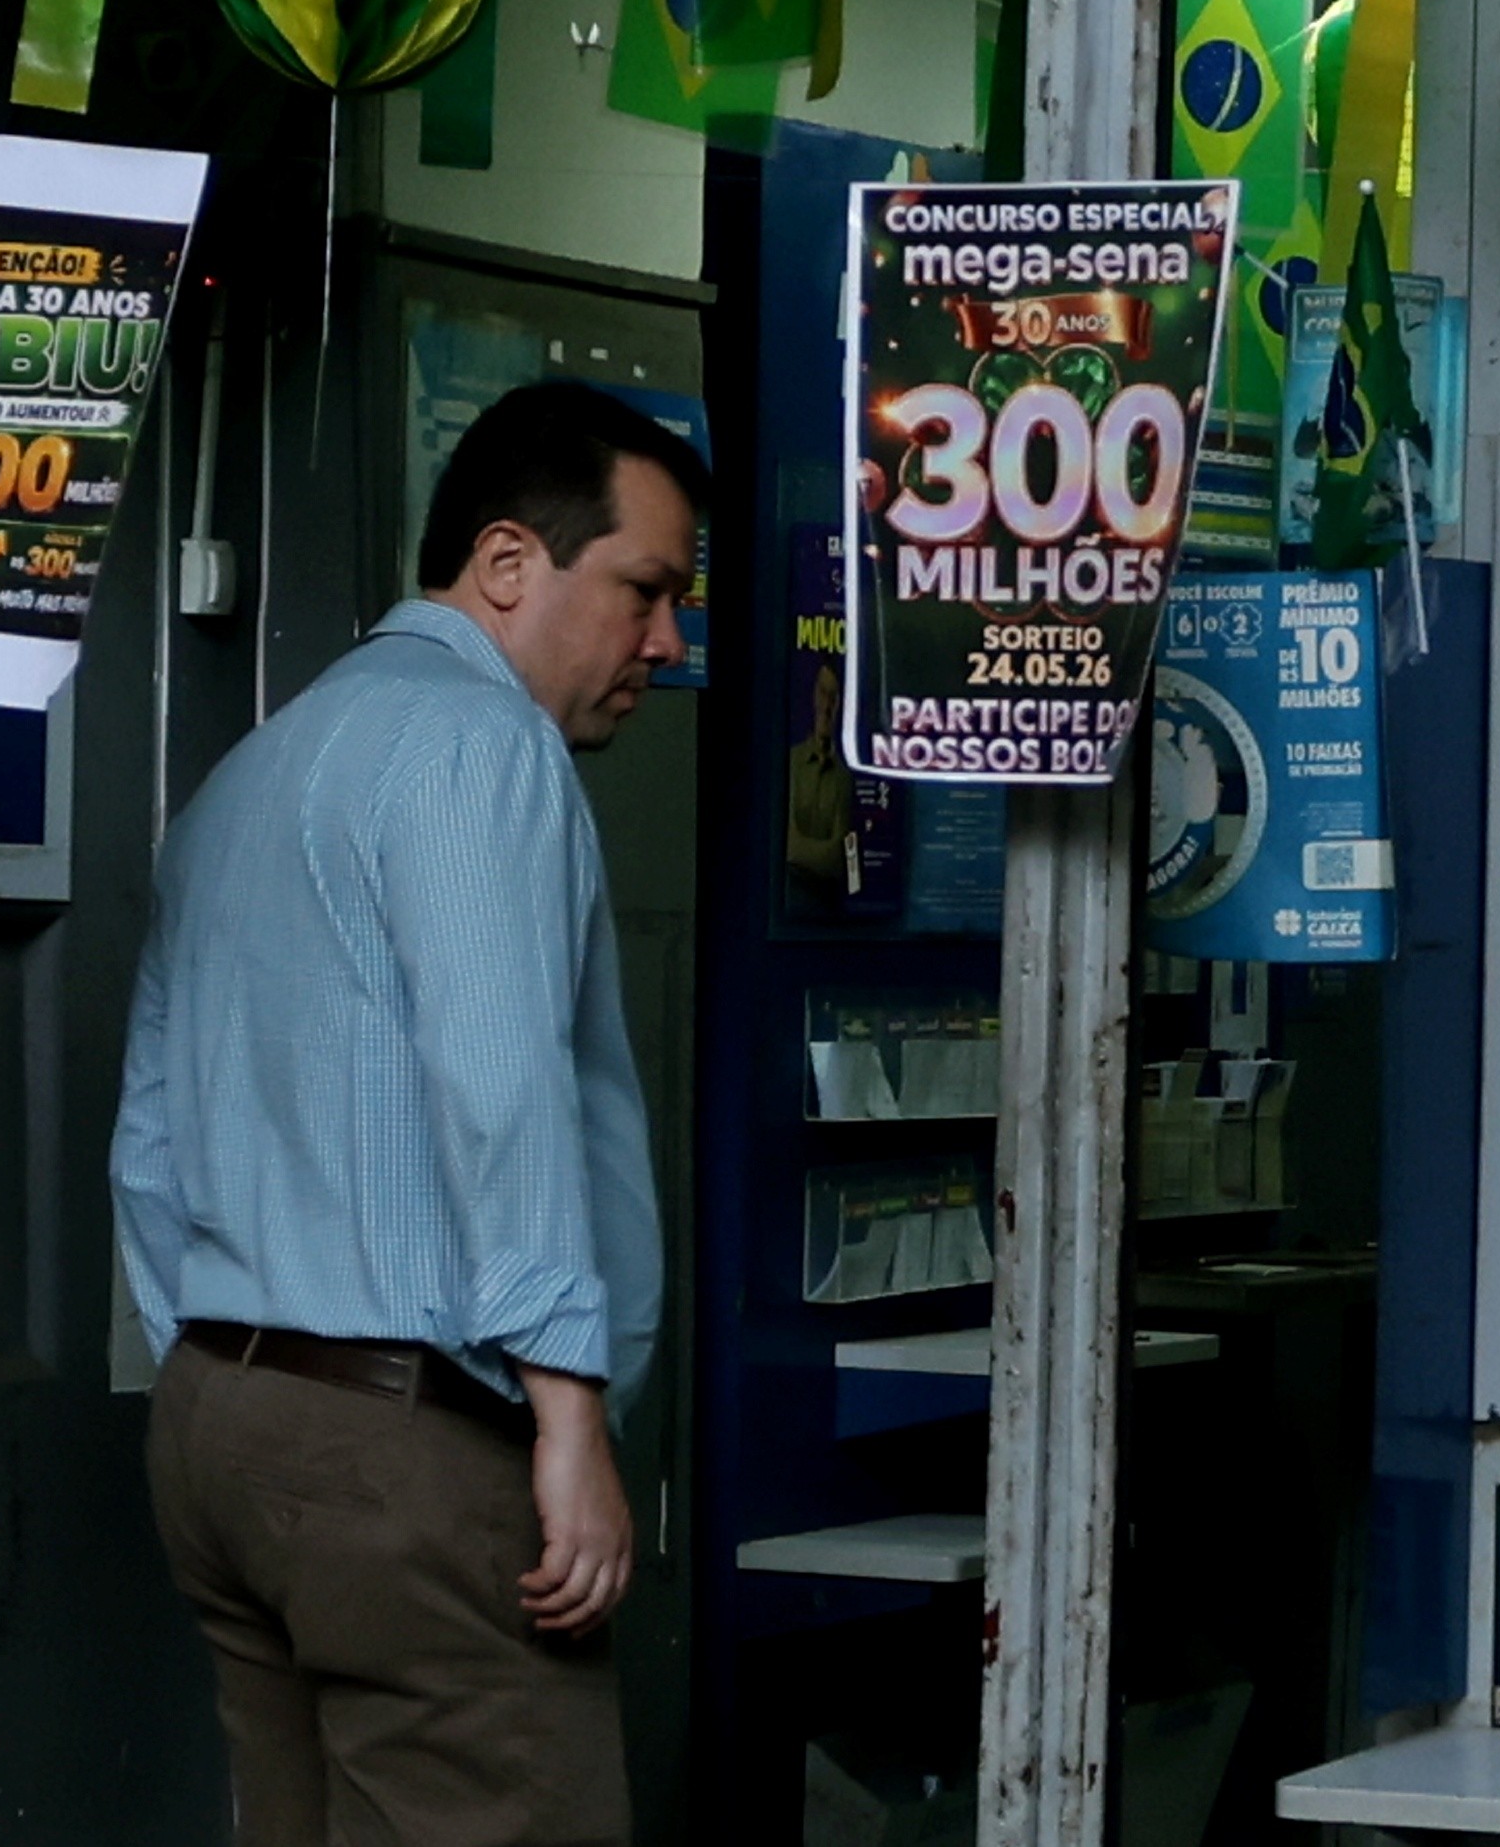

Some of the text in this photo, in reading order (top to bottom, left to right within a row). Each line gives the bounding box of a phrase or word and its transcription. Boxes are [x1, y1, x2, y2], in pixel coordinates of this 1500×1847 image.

[886, 202, 1208, 232] CONCURSO ESPECIAL
[904, 241, 1189, 292] mega-sena
[25, 288, 62, 314] 30
[69, 289, 151, 317] ANOS
[991, 301, 1111, 346] 30 ANOS
[6, 401, 95, 421] AUMENTOU!
[884, 382, 1188, 542] 300
[25, 545, 76, 579] 300
[897, 533, 1163, 605] MILHÕES
[1282, 579, 1359, 605] PRÊMIO
[983, 625, 1103, 650] SORTEIO
[1178, 613, 1248, 636] 6 2
[967, 653, 1111, 687] 24.05.26
[1294, 627, 1360, 683] 10
[1278, 683, 1362, 709] MILHÕES
[891, 697, 1089, 734] PARTICIPE
[871, 734, 1041, 773] NOSSOS
[1286, 741, 1362, 762] 10 FAIXAS
